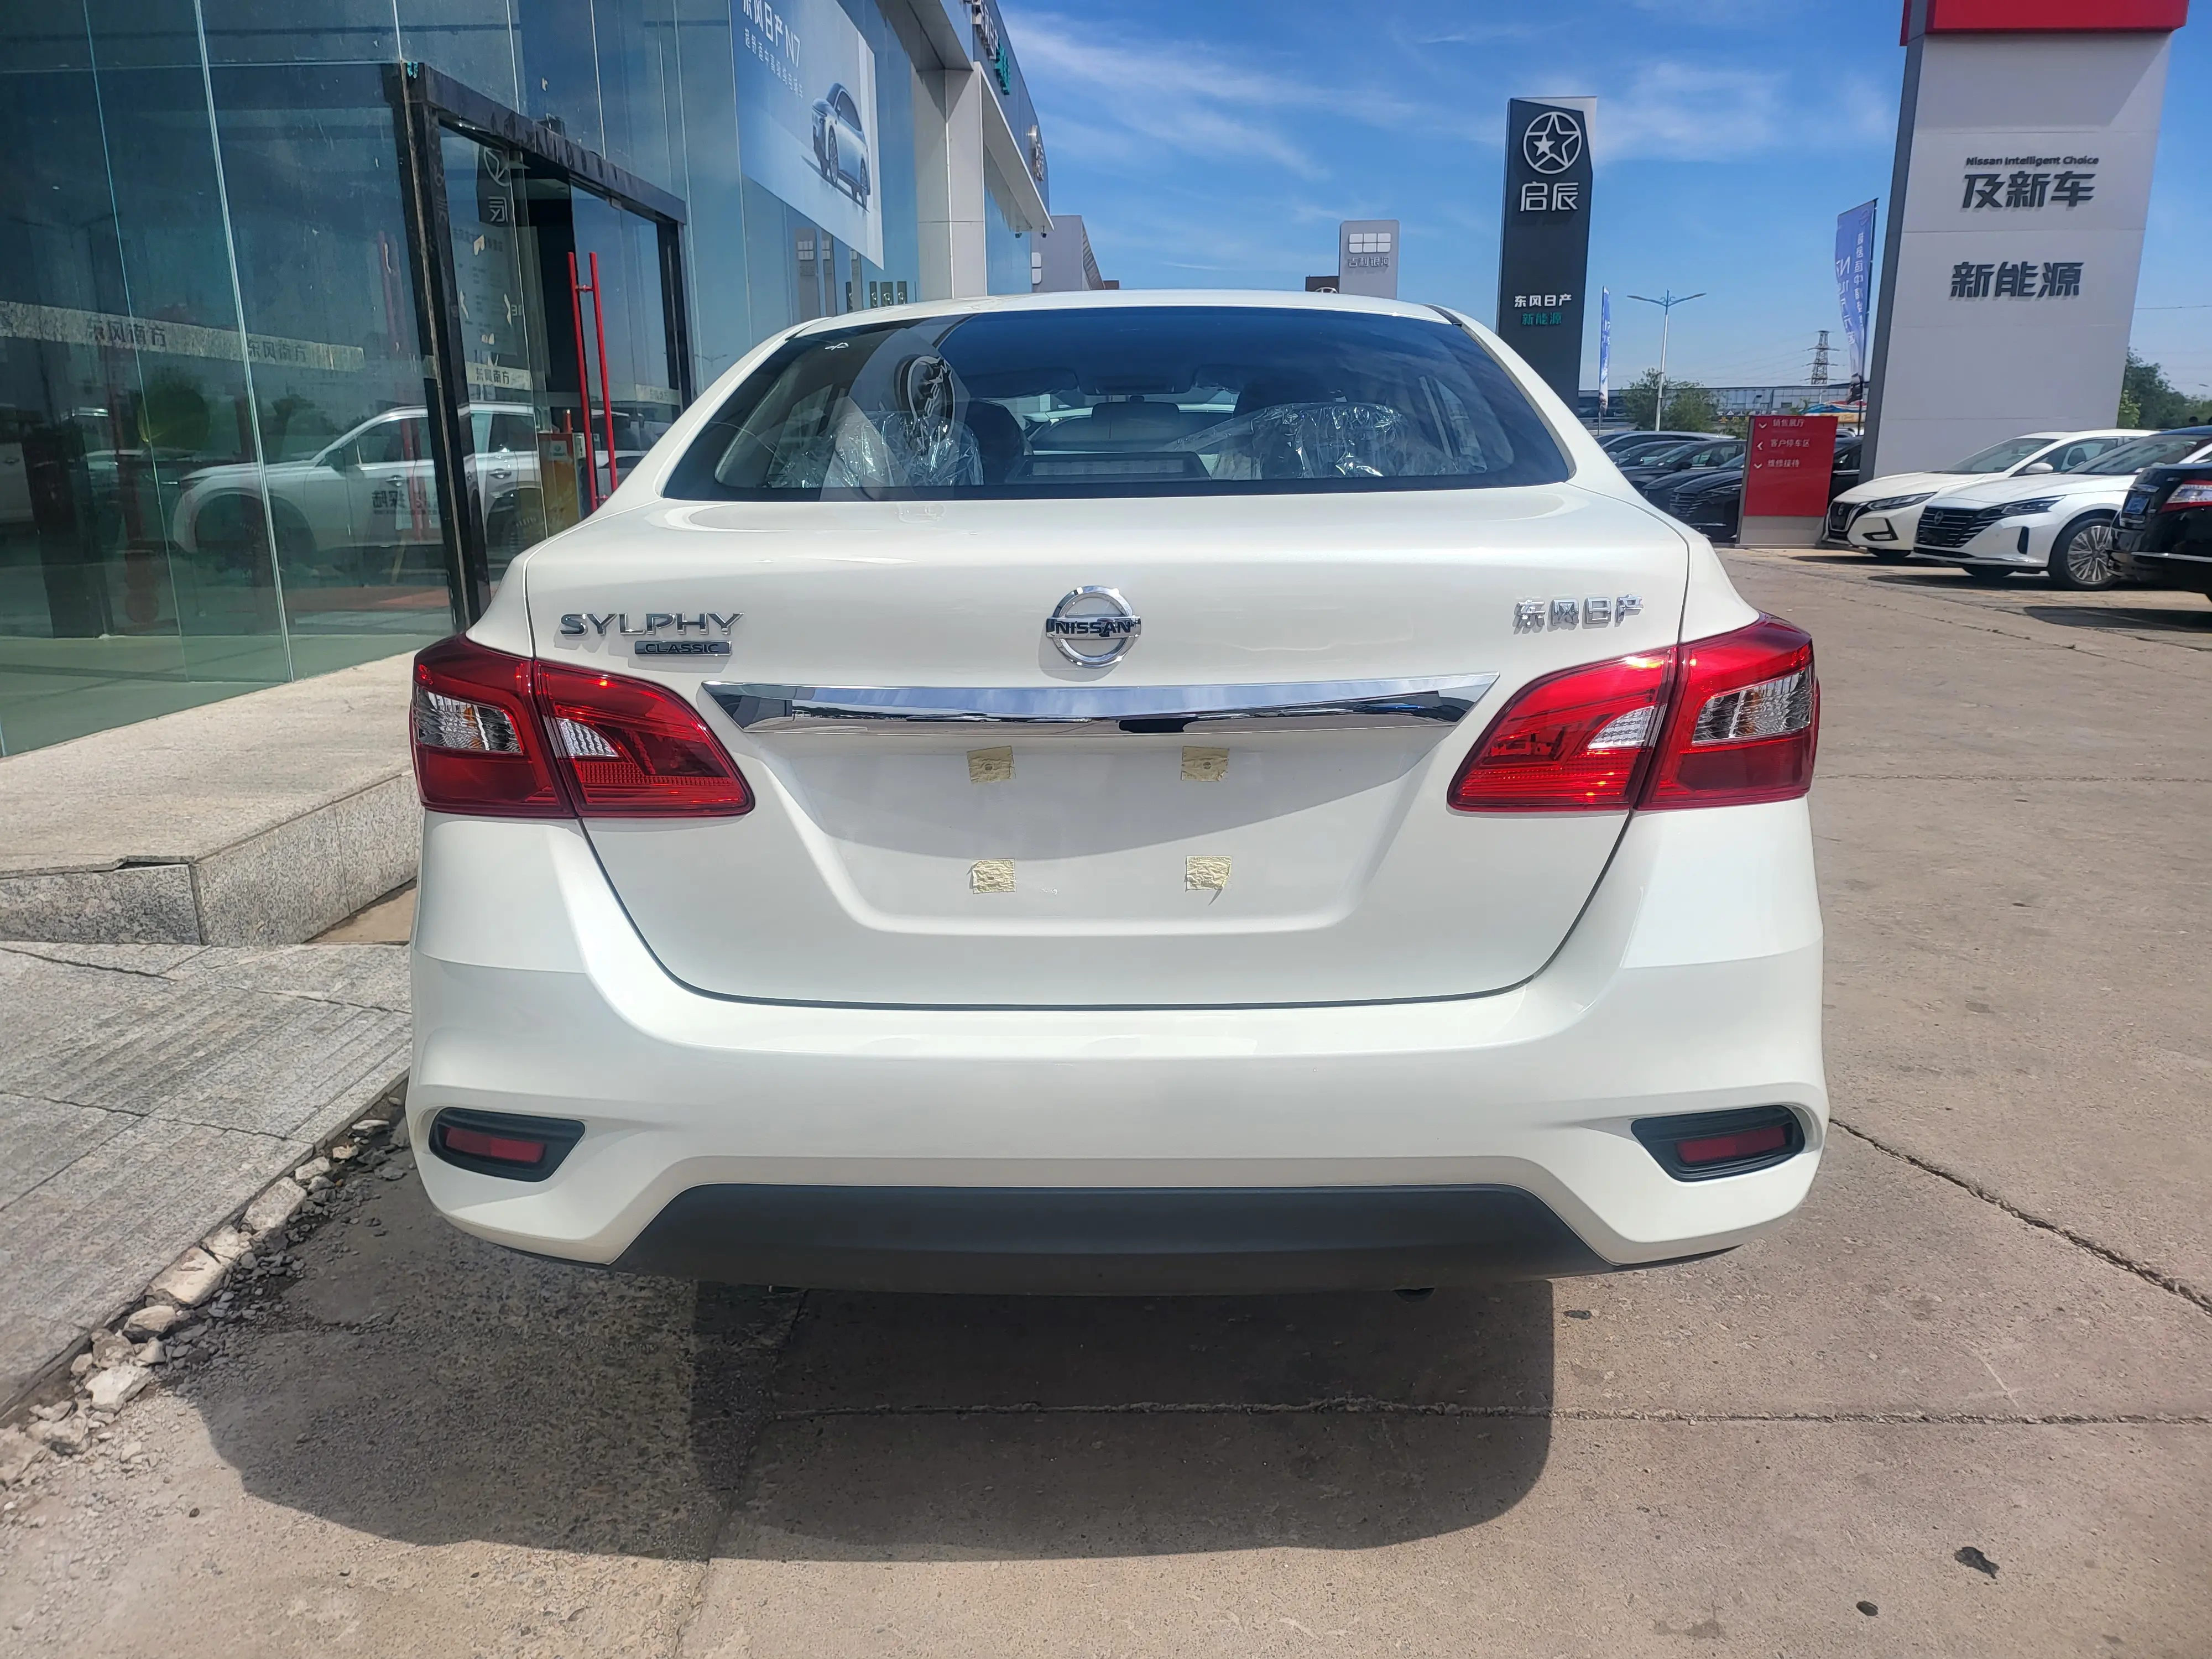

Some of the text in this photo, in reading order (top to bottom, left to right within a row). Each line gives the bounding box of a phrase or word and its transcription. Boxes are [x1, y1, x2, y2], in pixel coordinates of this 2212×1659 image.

[785, 24, 800, 68] N7
[1965, 155, 2099, 166] Nissan Intelligent Choice
[1520, 181, 1579, 212] 启辰
[1962, 170, 2096, 208] 及新车
[1348, 256, 1390, 268] 吉利银河
[1950, 261, 2084, 298] 新能源
[1514, 293, 1572, 307] 东风日产
[1521, 312, 1562, 325] 新能源
[1515, 594, 1645, 629] 东风日产
[560, 613, 745, 635] SYLPHY
[1056, 621, 1131, 634] NISSAN
[644, 643, 719, 654] CLASSIC
